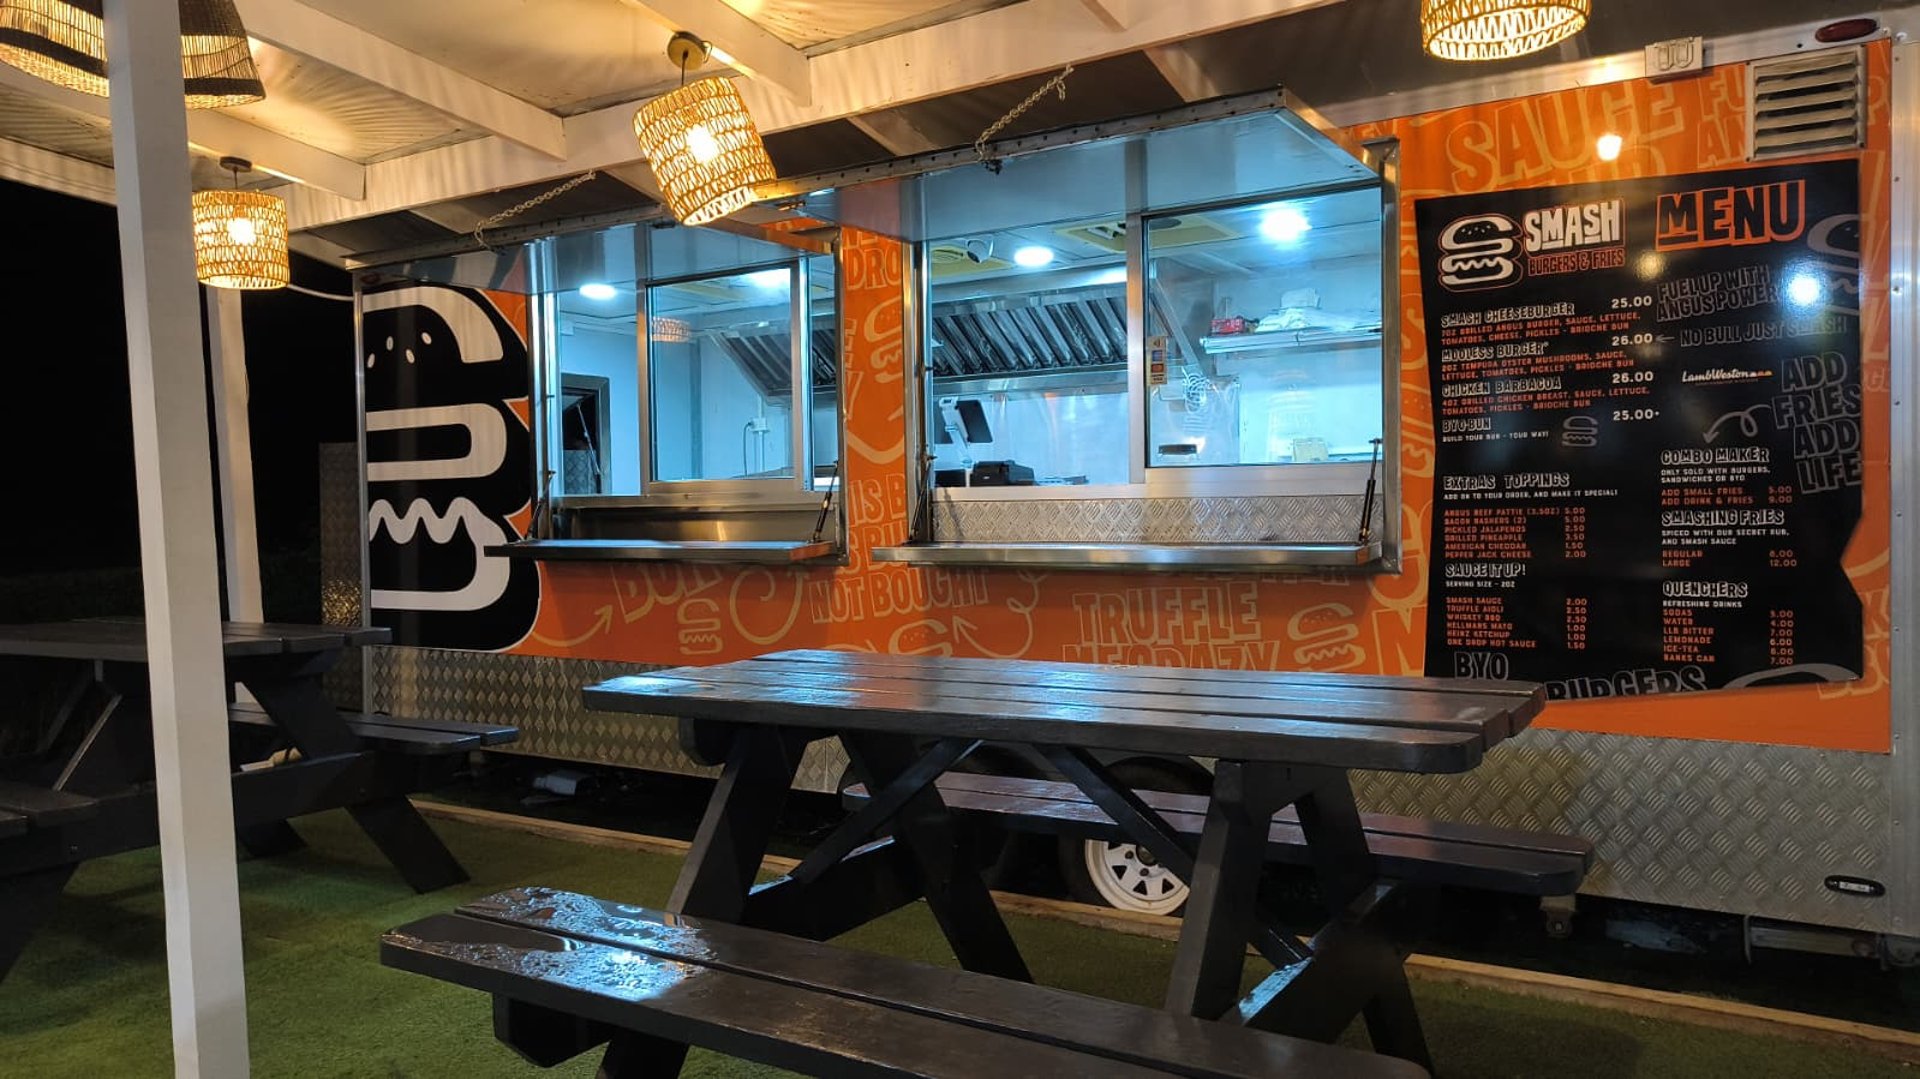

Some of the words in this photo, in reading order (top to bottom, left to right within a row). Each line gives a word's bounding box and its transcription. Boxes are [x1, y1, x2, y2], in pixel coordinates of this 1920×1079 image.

[1524, 198, 1623, 254] SMASH
[1655, 179, 1806, 252] MENU
[1528, 255, 1576, 276] BURGERS
[1579, 253, 1590, 270] &
[1592, 249, 1625, 269] FRIES
[1657, 278, 1700, 304] FUEL
[1700, 271, 1722, 294] UP
[1722, 264, 1771, 292] WITH
[1441, 313, 1481, 328] SMASH
[1485, 302, 1575, 324] CHEESEBURGER
[1612, 296, 1652, 308] 25.00
[1656, 292, 1716, 322] ANGUS
[1716, 285, 1781, 311] POWER
[1570, 323, 1607, 333] BRIOCHE
[1611, 322, 1629, 330] BUN
[1680, 329, 1704, 347] NO
[1705, 325, 1742, 345] BULL
[1442, 347, 1494, 362] MOOLESS
[1612, 333, 1652, 347] 26.00
[1575, 360, 1612, 370] BRIOCHE
[1781, 351, 1847, 393] ADD
[1442, 382, 1490, 398] CHICKEN
[1495, 375, 1562, 394] BARBACOA
[1613, 371, 1653, 383] 26.00
[1772, 384, 1861, 430] FRIES
[1794, 418, 1861, 460] ADD
[1661, 450, 1713, 465] COMBO
[1716, 447, 1769, 463] MAKER
[1444, 475, 1495, 490] EXTRAS
[1505, 473, 1569, 489] TOPPINGS
[1795, 451, 1862, 495] LIFE
[1684, 488, 1713, 496] SMALL
[1717, 487, 1742, 495] FRIES
[1728, 496, 1753, 504] FRIES
[1662, 510, 1738, 526] SMASHING
[1740, 509, 1784, 525] FRIES
[1663, 550, 1702, 558] REGULAR
[1663, 559, 1690, 567] LARGE
[1770, 559, 1797, 567] 12.00
[1446, 563, 1487, 577] SAUCE
[1489, 564, 1502, 578] IT
[1504, 563, 1525, 577] UP!
[809, 577, 864, 624] NOT
[868, 567, 989, 617] BOUGHT
[1663, 582, 1748, 598] QUENCHERS
[1072, 581, 1261, 645] TRUFFLE
[1509, 640, 1535, 648] SAUCE
[1683, 627, 1713, 635] BITTER
[1454, 651, 1509, 681] BYO
